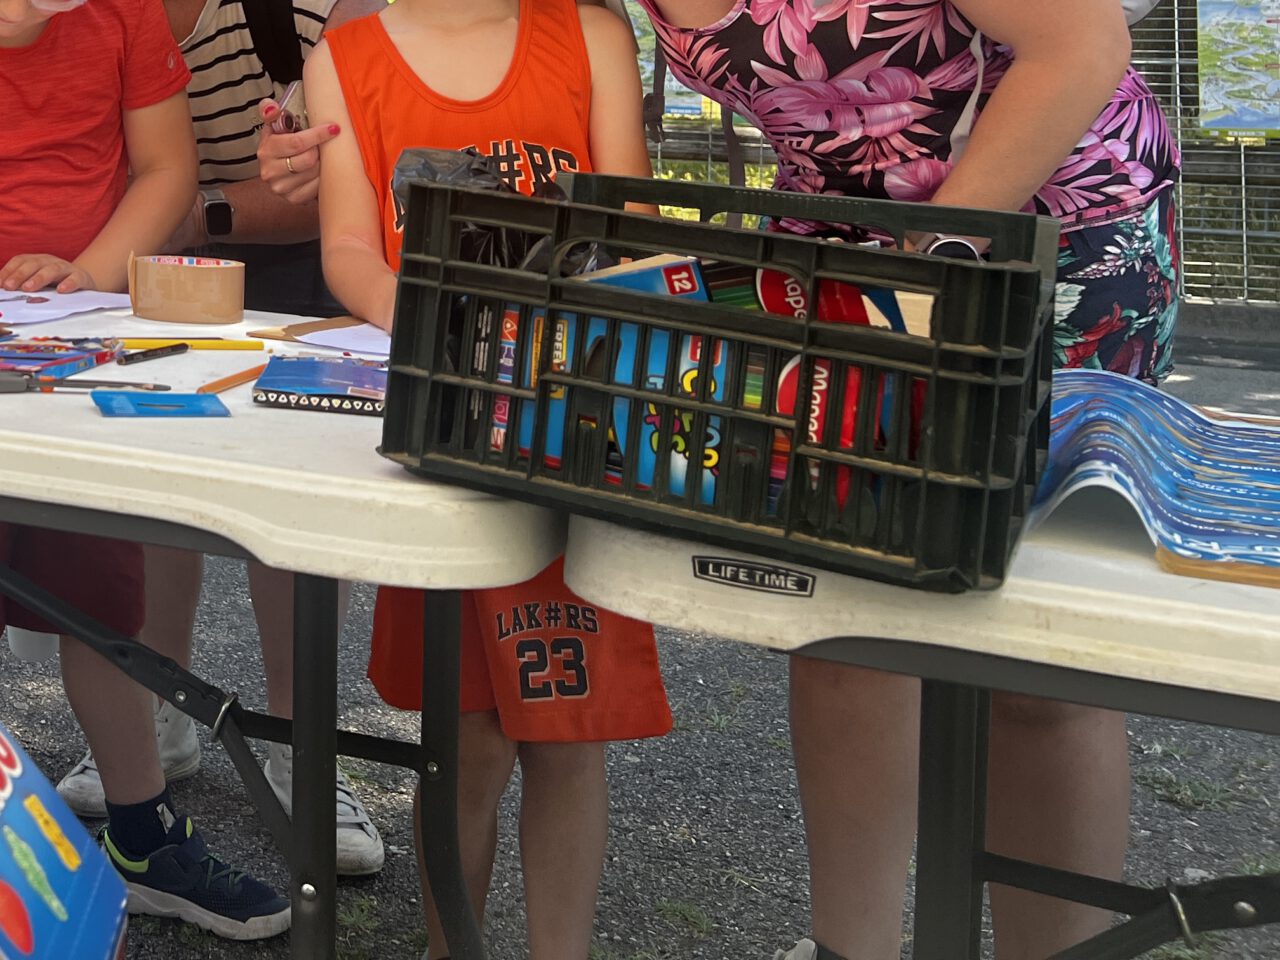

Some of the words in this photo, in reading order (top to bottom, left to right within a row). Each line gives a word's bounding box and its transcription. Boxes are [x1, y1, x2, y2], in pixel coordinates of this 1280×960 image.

[670, 271, 692, 292] 12
[708, 562, 798, 590] LIFETIME
[496, 601, 600, 642] LAK#RS
[516, 636, 590, 702] 23
